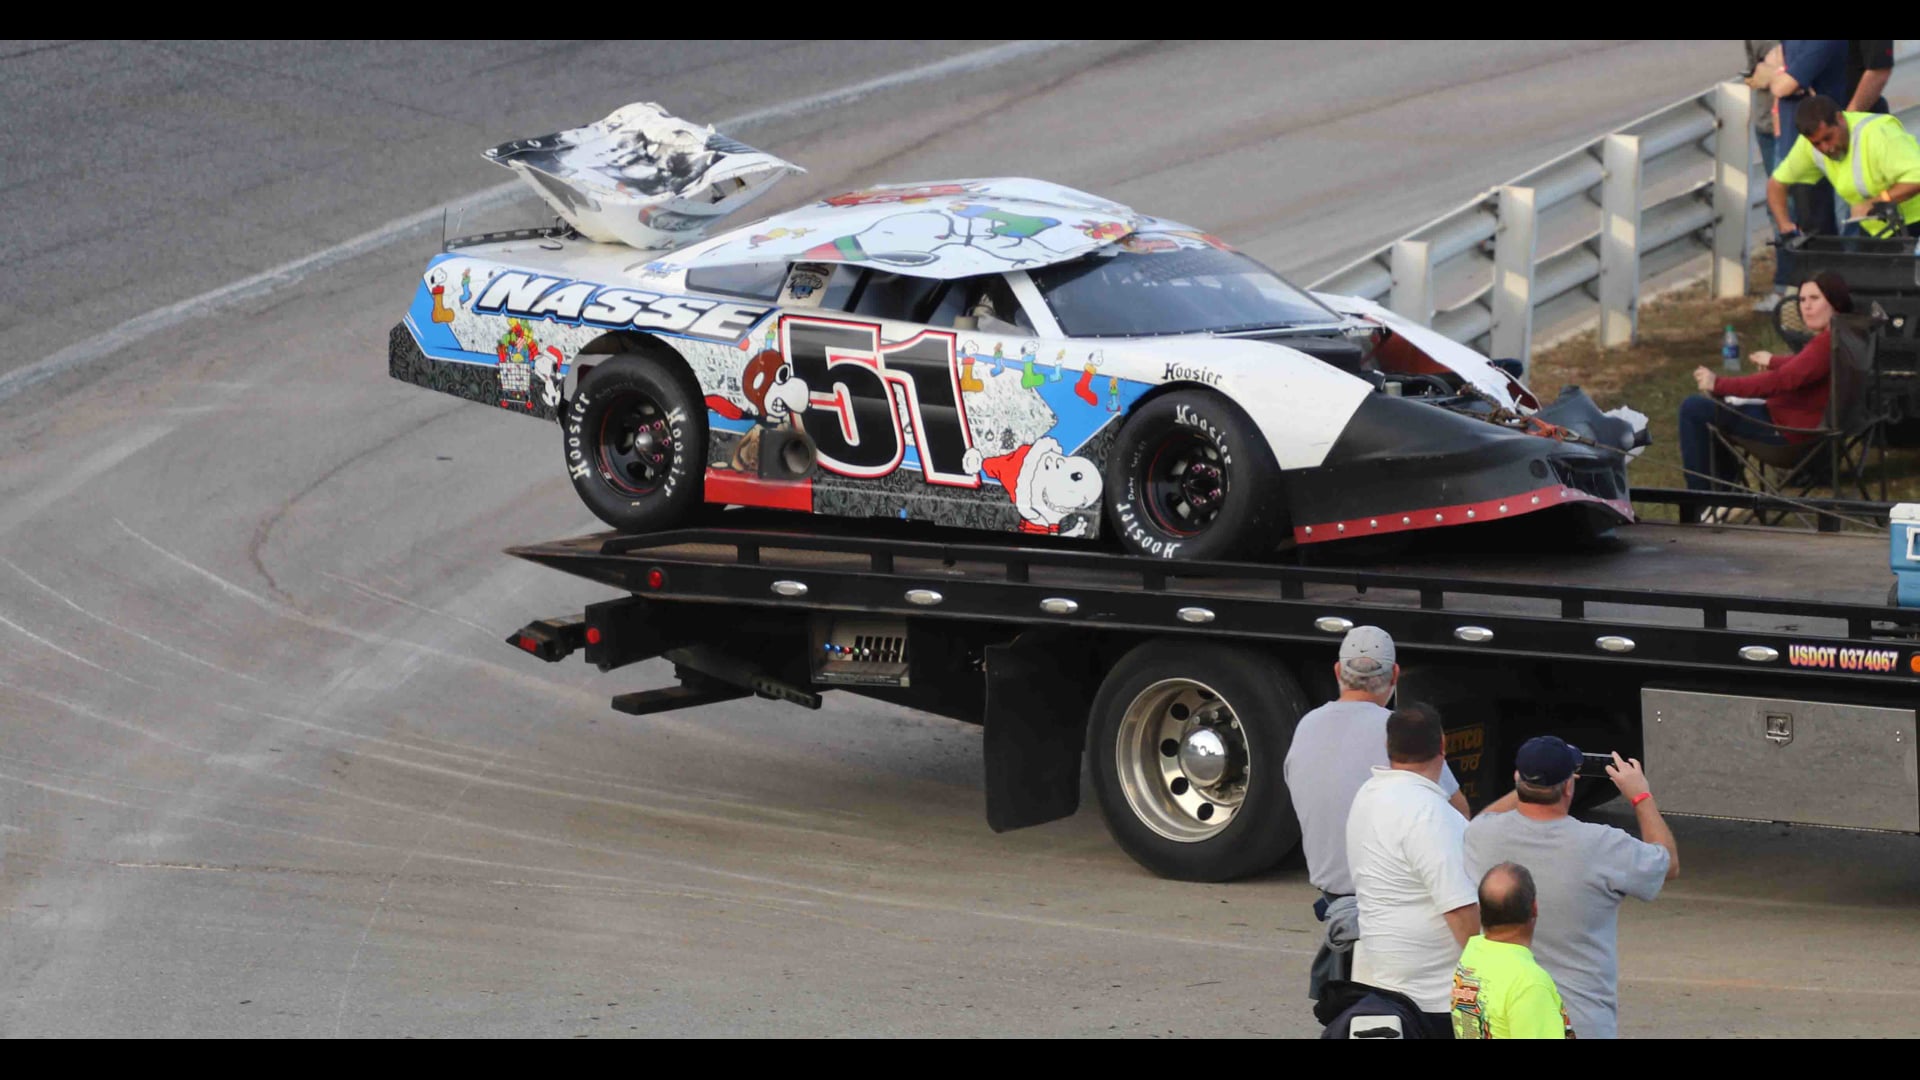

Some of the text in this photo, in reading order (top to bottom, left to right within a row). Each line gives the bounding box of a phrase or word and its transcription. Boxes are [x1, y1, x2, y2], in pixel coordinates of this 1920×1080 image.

[474, 271, 779, 344] NASSE
[779, 314, 982, 488] 51
[1161, 363, 1223, 385] Hoosier
[568, 392, 592, 481] Hoosier
[664, 406, 687, 498] Hoosier
[1174, 404, 1232, 465] Hoosier
[1116, 502, 1184, 559] Hoosier
[1788, 644, 1899, 672] USDOT 0374067
